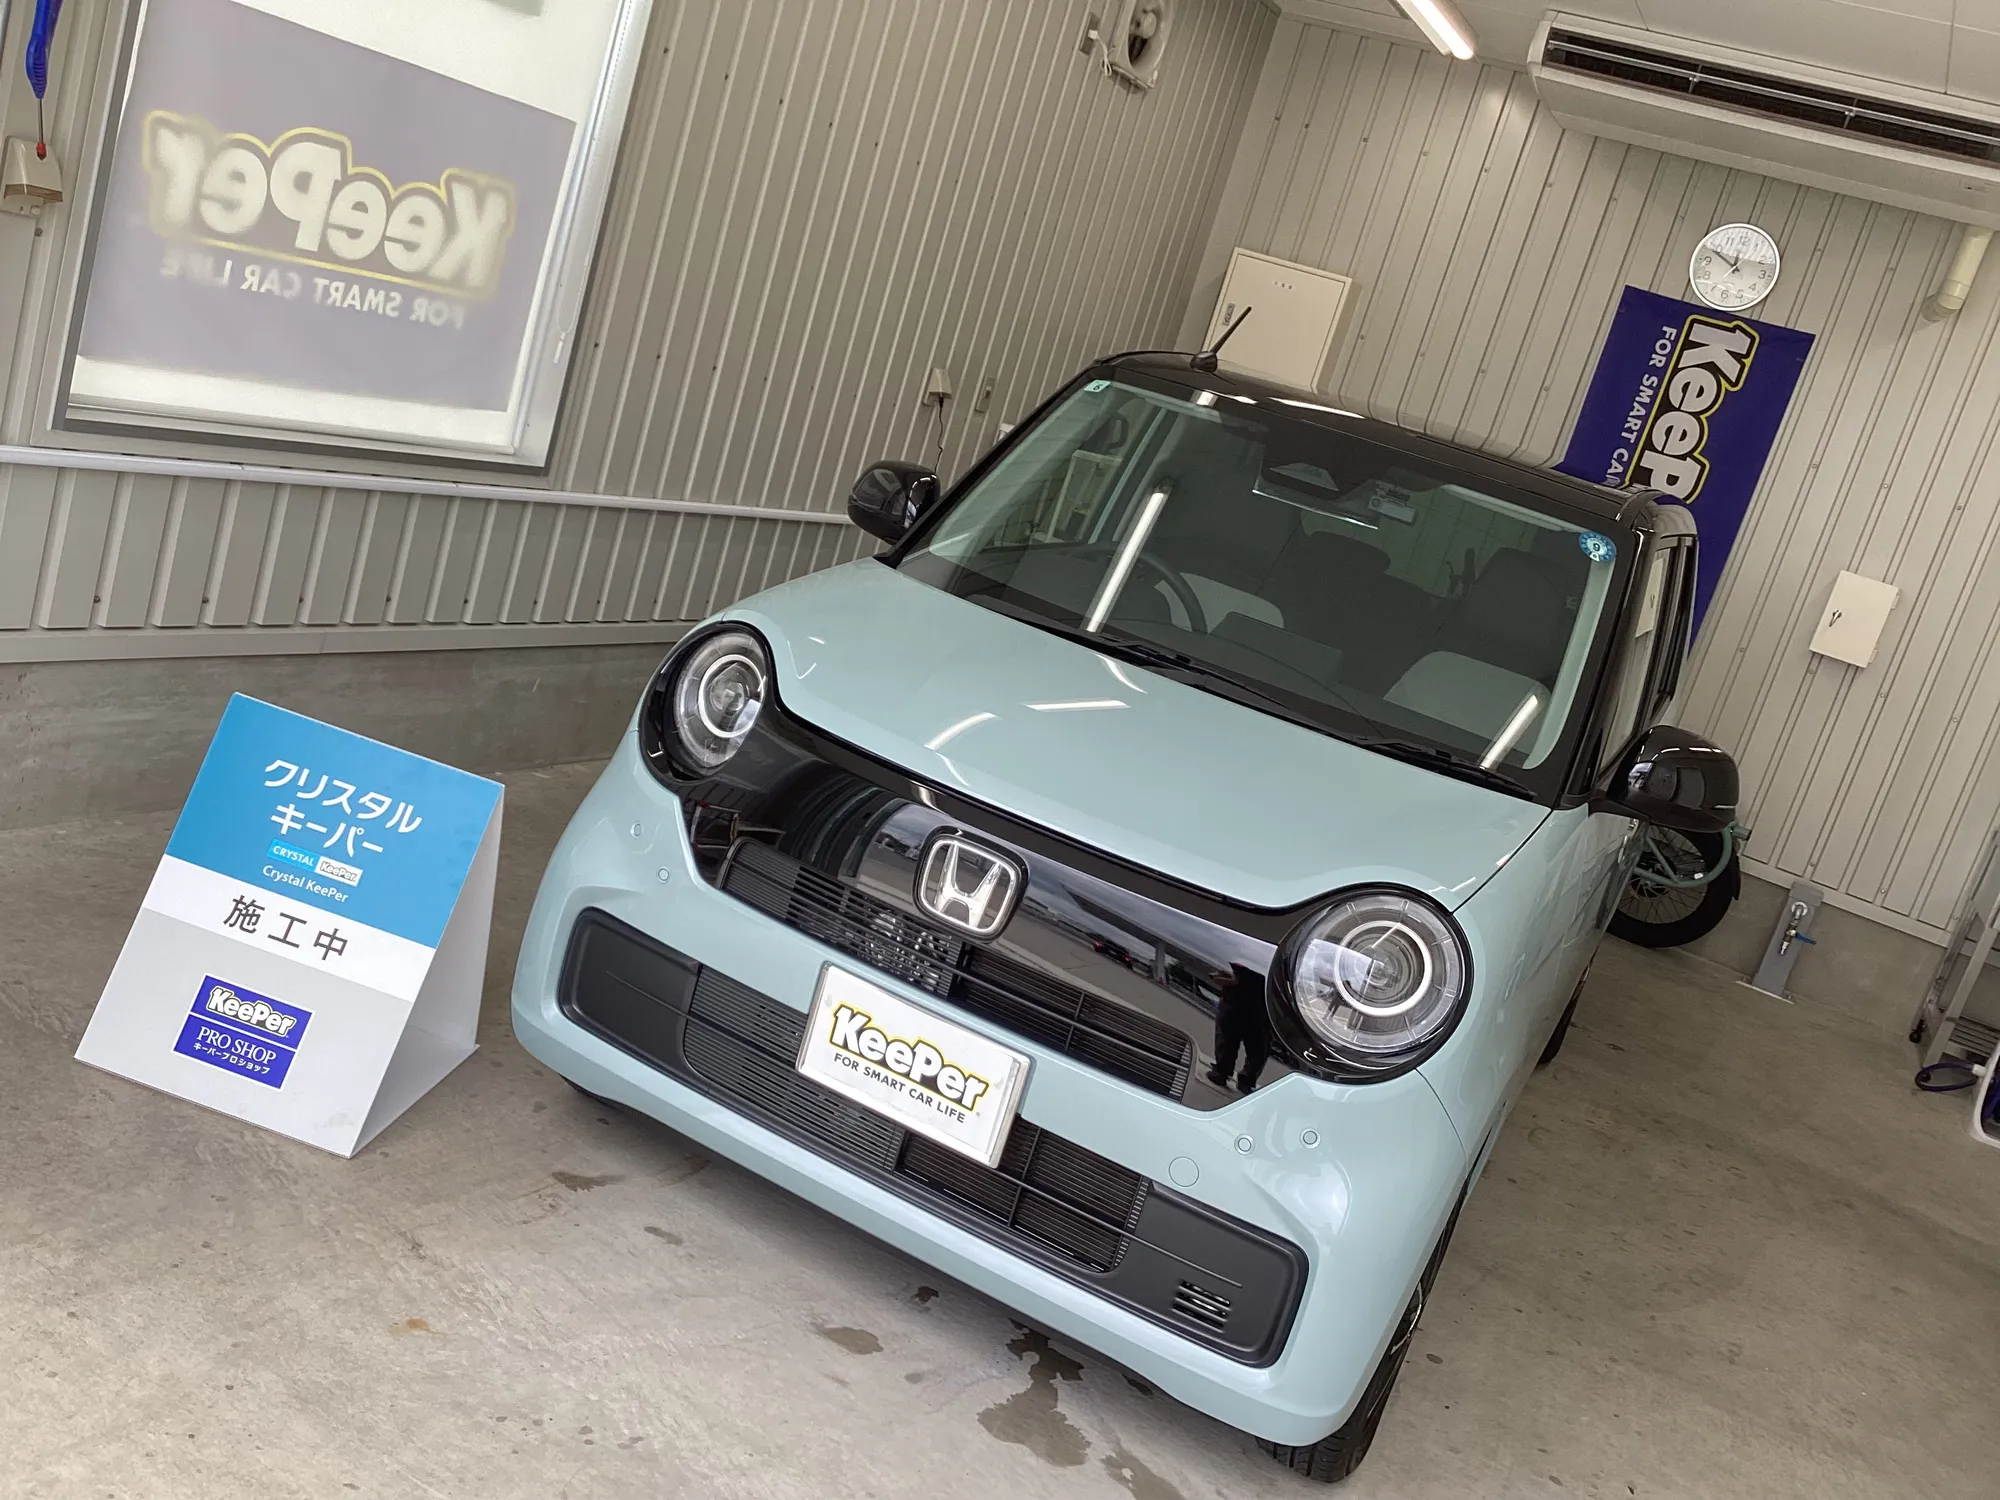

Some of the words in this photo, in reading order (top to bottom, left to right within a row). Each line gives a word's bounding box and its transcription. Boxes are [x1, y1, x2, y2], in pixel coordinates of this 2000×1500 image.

[1720, 289, 1730, 300] 6
[1748, 282, 1757, 292] 4
[1757, 269, 1767, 280] 3
[1648, 325, 1678, 368] FOR
[1621, 373, 1659, 444] SMART
[263, 759, 423, 833] クリスタル
[270, 803, 384, 858] キーパー
[262, 864, 305, 888] Crystal
[305, 879, 349, 903] KeePer
[272, 844, 315, 868] CRYSTAL
[319, 860, 358, 883] KeePer
[222, 894, 349, 961] 施工中
[206, 986, 297, 1036] KeePer
[195, 1025, 232, 1049] PRO
[231, 1038, 277, 1065] SHOP
[830, 1003, 990, 1112] KeePer
[833, 1051, 860, 1072] FOR
[863, 1066, 905, 1093] SMART
[908, 1087, 933, 1107] CAR
[936, 1102, 967, 1124] LIFE
